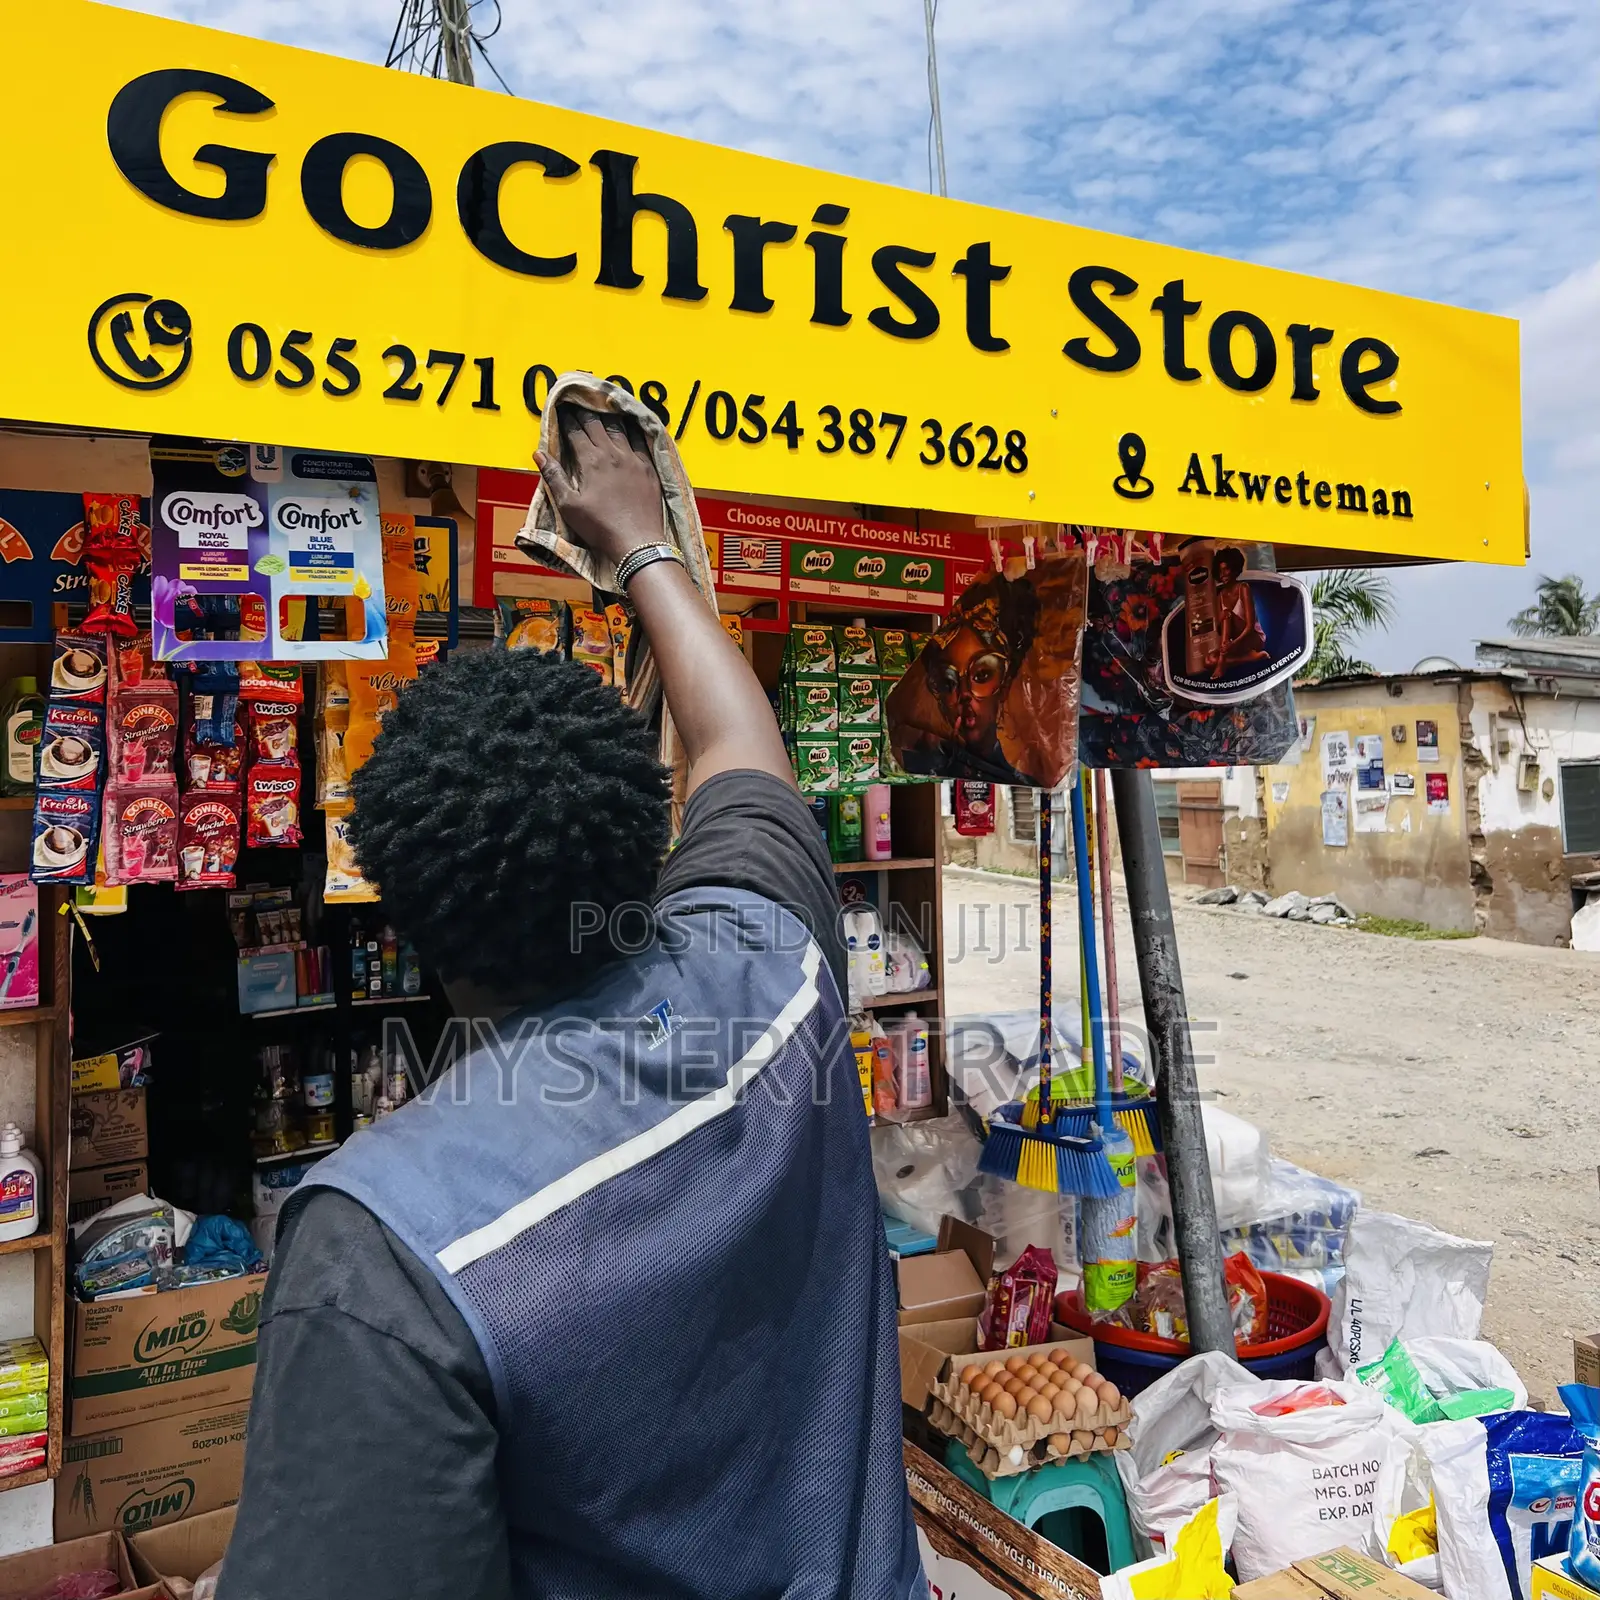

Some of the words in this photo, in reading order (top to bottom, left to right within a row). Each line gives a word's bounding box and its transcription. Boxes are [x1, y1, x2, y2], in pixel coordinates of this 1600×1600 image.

[107, 68, 1012, 353] GoChrist
[1062, 265, 1403, 415] Store
[227, 322, 361, 397] 055
[382, 345, 501, 411] 271
[817, 406, 908, 460] 387
[920, 419, 1028, 474] 3628
[302, 460, 353, 469] CONCENTRATED
[302, 467, 325, 475] FABRIC
[326, 468, 371, 477] CONDITIONER
[1178, 453, 1414, 518] Akweteman
[167, 497, 258, 530] Comfort
[278, 502, 363, 534] Comfort
[198, 532, 229, 540] ROYAL
[726, 508, 781, 528] Choose
[784, 515, 848, 538] QUALITY,
[851, 523, 900, 543] Choose
[903, 530, 951, 549] NESTLÉ
[740, 541, 767, 560] Ideal
[806, 557, 831, 567] MILO
[858, 563, 883, 573] MILO
[905, 568, 929, 578] MILO
[1183, 679, 1218, 689] BEAUTIFULLY
[1218, 675, 1257, 689] MOISTURIZED
[1256, 667, 1271, 679] SKIN
[1270, 646, 1302, 671] EVERYDAY
[810, 692, 828, 700] MILO
[852, 684, 871, 692] MILO
[51, 709, 98, 723] Kremela
[127, 706, 169, 723] COWBELL
[255, 703, 296, 714] twisco
[124, 724, 170, 740] Strawberry
[850, 742, 870, 750] MILO
[255, 780, 295, 791] twisco
[41, 797, 89, 811] Kremela
[126, 799, 169, 816] COWBELL
[189, 804, 231, 820] COWBELL
[123, 816, 169, 834] Strawberry
[196, 820, 225, 833] Mocha
[145, 1319, 207, 1352] MILO
[1349, 1318, 1363, 1364] 40PCSx6
[139, 1367, 160, 1380] All
[163, 1363, 176, 1373] In
[180, 1358, 208, 1370] One
[1312, 1463, 1359, 1480] BATCH
[1314, 1485, 1351, 1500] MFG.
[1354, 1480, 1376, 1497] DAT
[123, 1490, 185, 1525] MILO
[1318, 1506, 1349, 1521] EXP.
[1352, 1501, 1373, 1517] DAT
[1004, 1544, 1025, 1567] FDA
[1038, 1568, 1076, 1596] Advert
